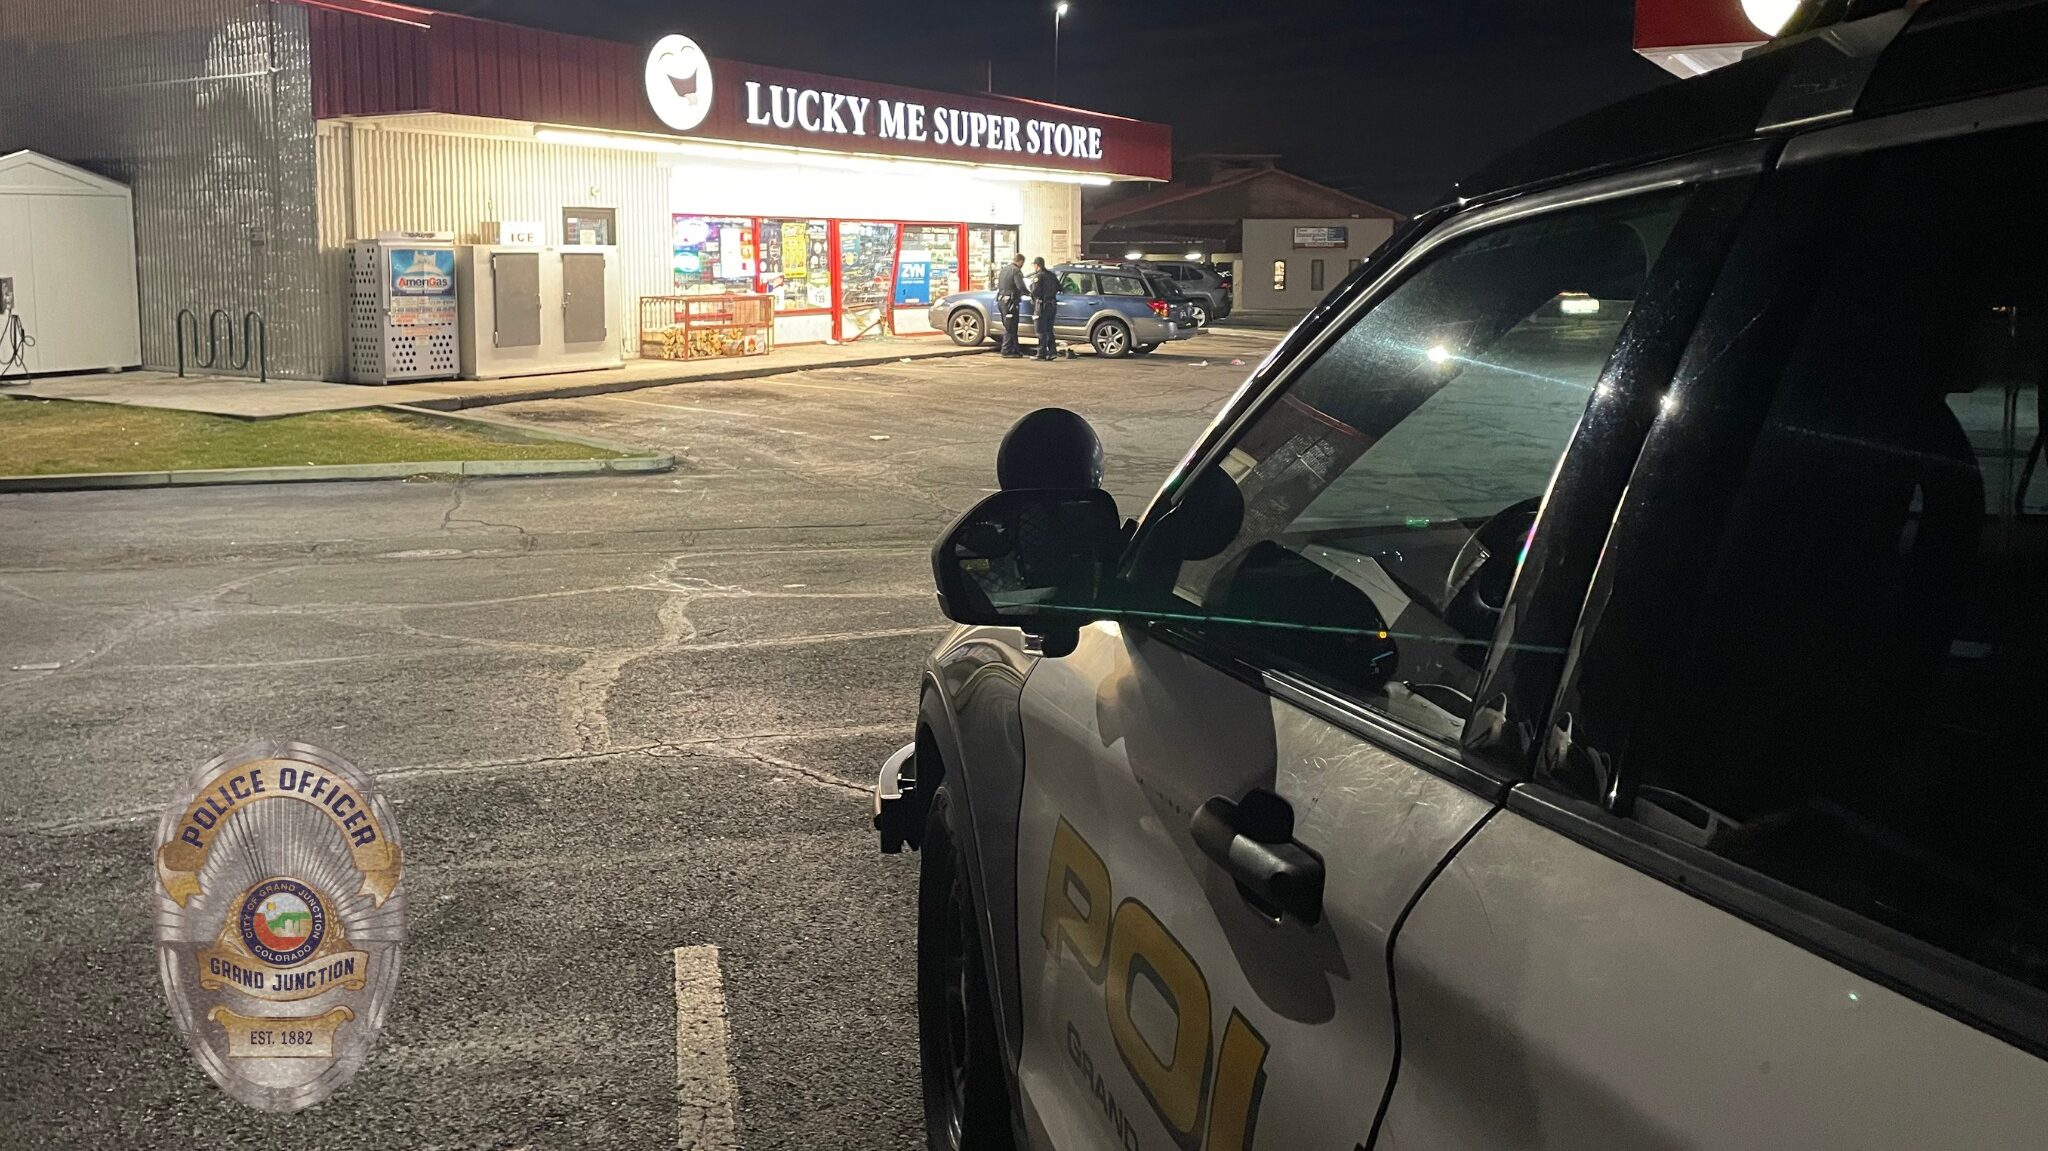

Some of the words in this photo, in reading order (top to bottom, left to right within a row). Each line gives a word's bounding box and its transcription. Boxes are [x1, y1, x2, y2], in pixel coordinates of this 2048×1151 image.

[745, 81, 871, 136] LUCKY
[879, 100, 928, 142] ME
[933, 107, 1022, 151] SUPER
[1026, 120, 1103, 159] STORE
[511, 232, 535, 242] ICE
[901, 263, 926, 278] ZYN
[398, 277, 448, 288] AmeriGas
[1066, 1020, 1139, 1151] GRAND
